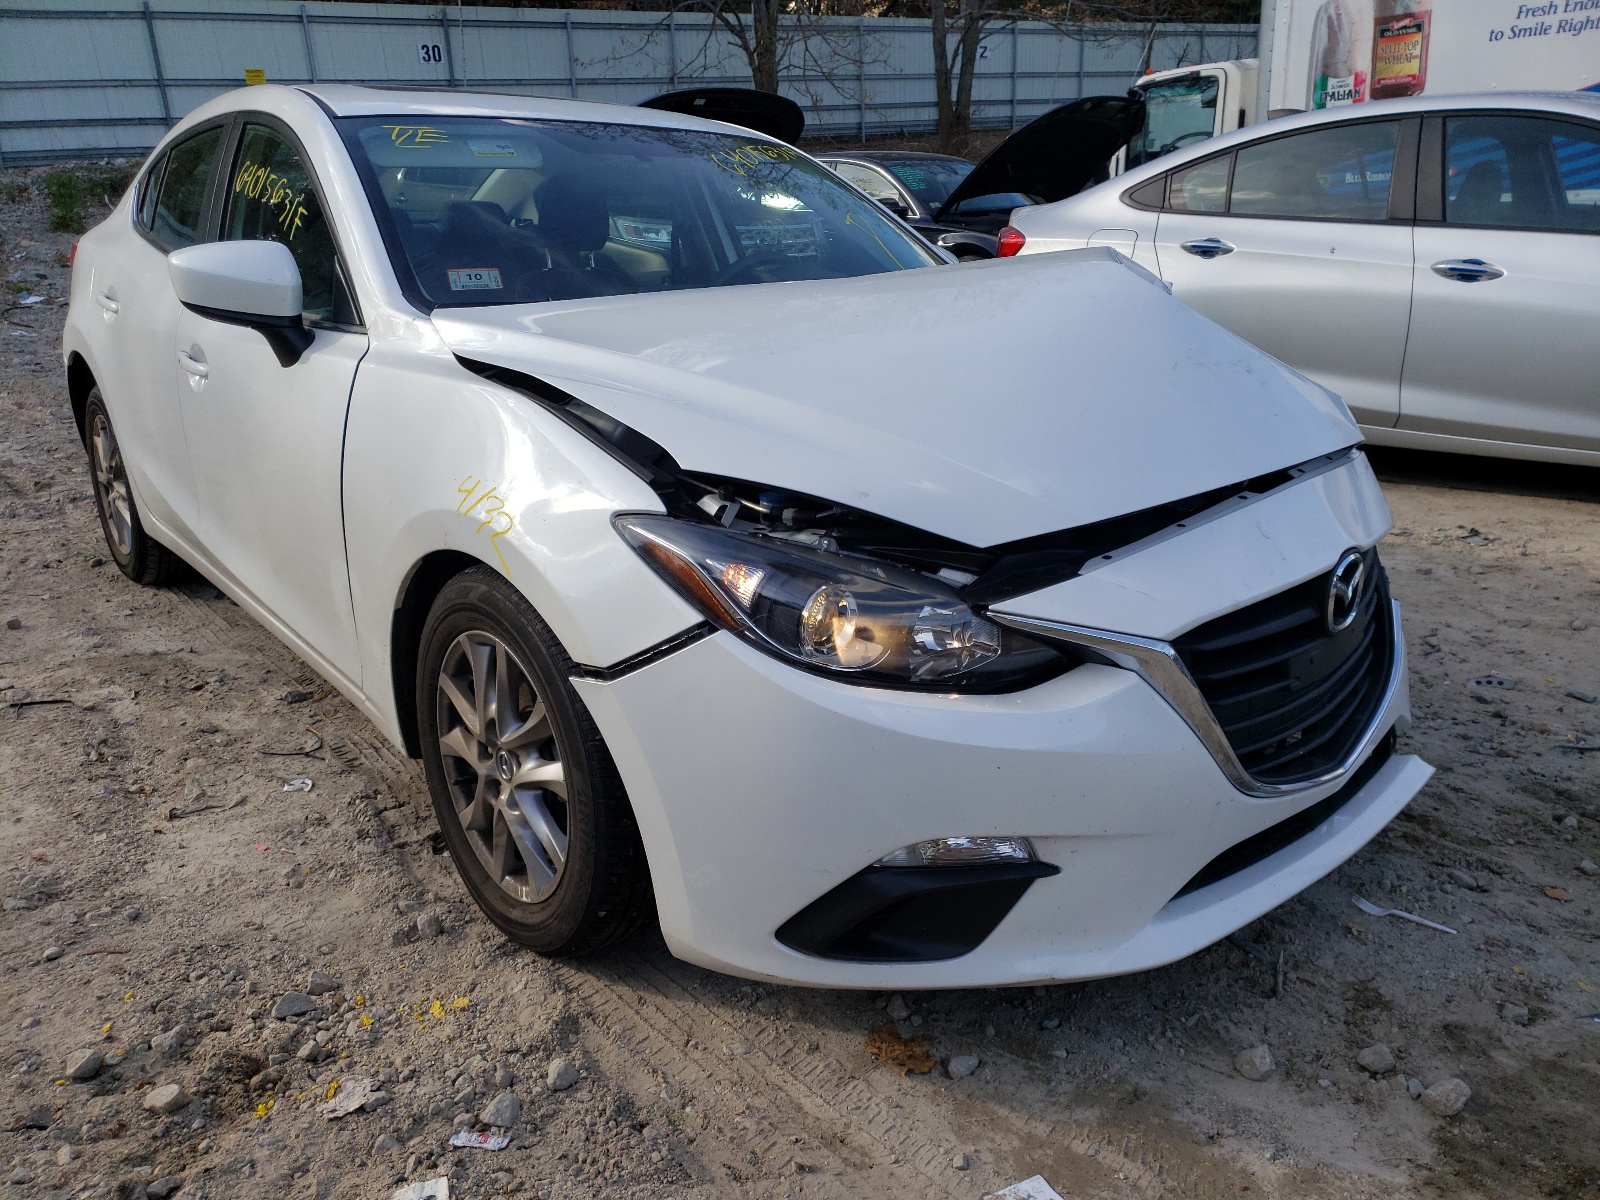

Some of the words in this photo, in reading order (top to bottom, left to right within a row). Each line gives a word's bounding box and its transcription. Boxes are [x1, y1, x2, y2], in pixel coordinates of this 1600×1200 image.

[1515, 1, 1557, 20] Fresh
[1489, 29, 1504, 42] to
[1508, 21, 1552, 40] Smile
[421, 44, 442, 63] 30
[1384, 53, 1413, 65] WHEAT
[1319, 88, 1361, 103] ITALIAN
[465, 273, 483, 281] 10
